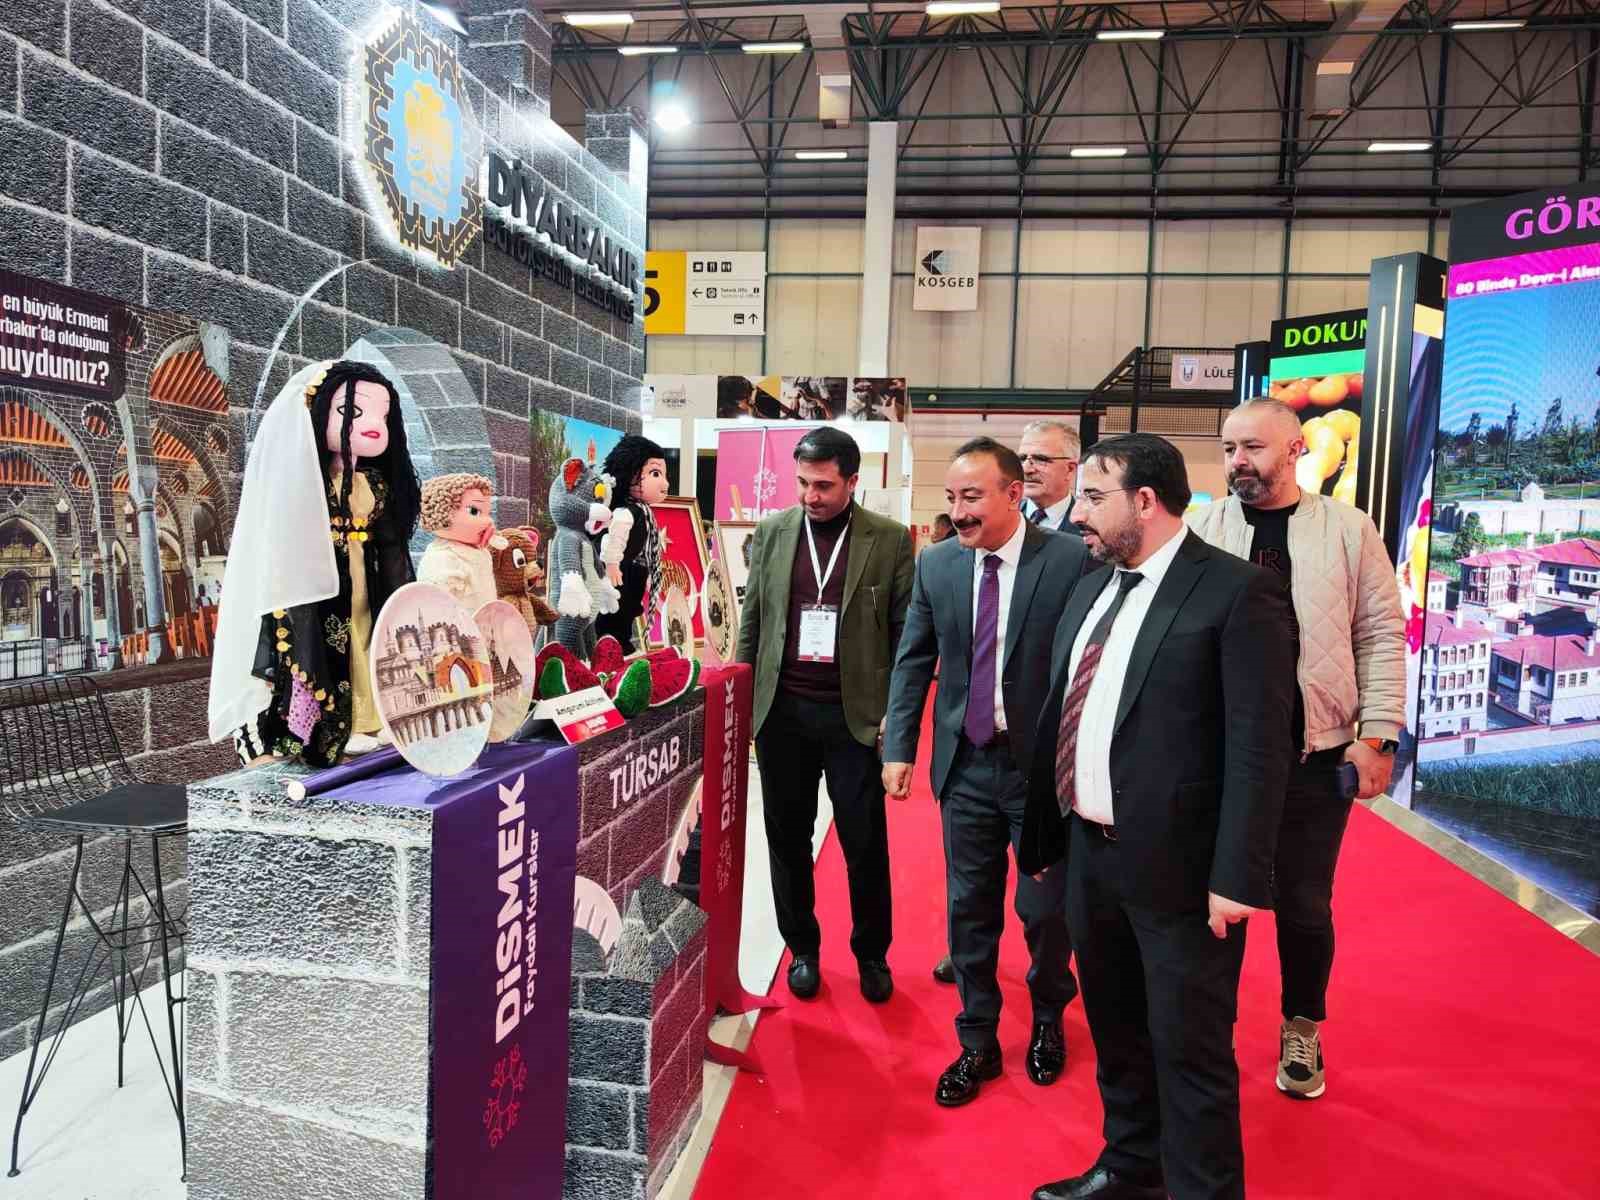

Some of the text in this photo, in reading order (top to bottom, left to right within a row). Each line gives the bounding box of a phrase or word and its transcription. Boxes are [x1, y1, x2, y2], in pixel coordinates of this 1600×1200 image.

[487, 152, 638, 294] DİYARBAKIR
[1505, 195, 1600, 240] GÖR
[918, 276, 975, 288] KOSGEB
[2, 294, 109, 333] en büyük Ermeni
[58, 328, 110, 354] olduğunu
[609, 735, 680, 810] TÜRSAB
[523, 828, 540, 1016] Faydalı Kurslar
